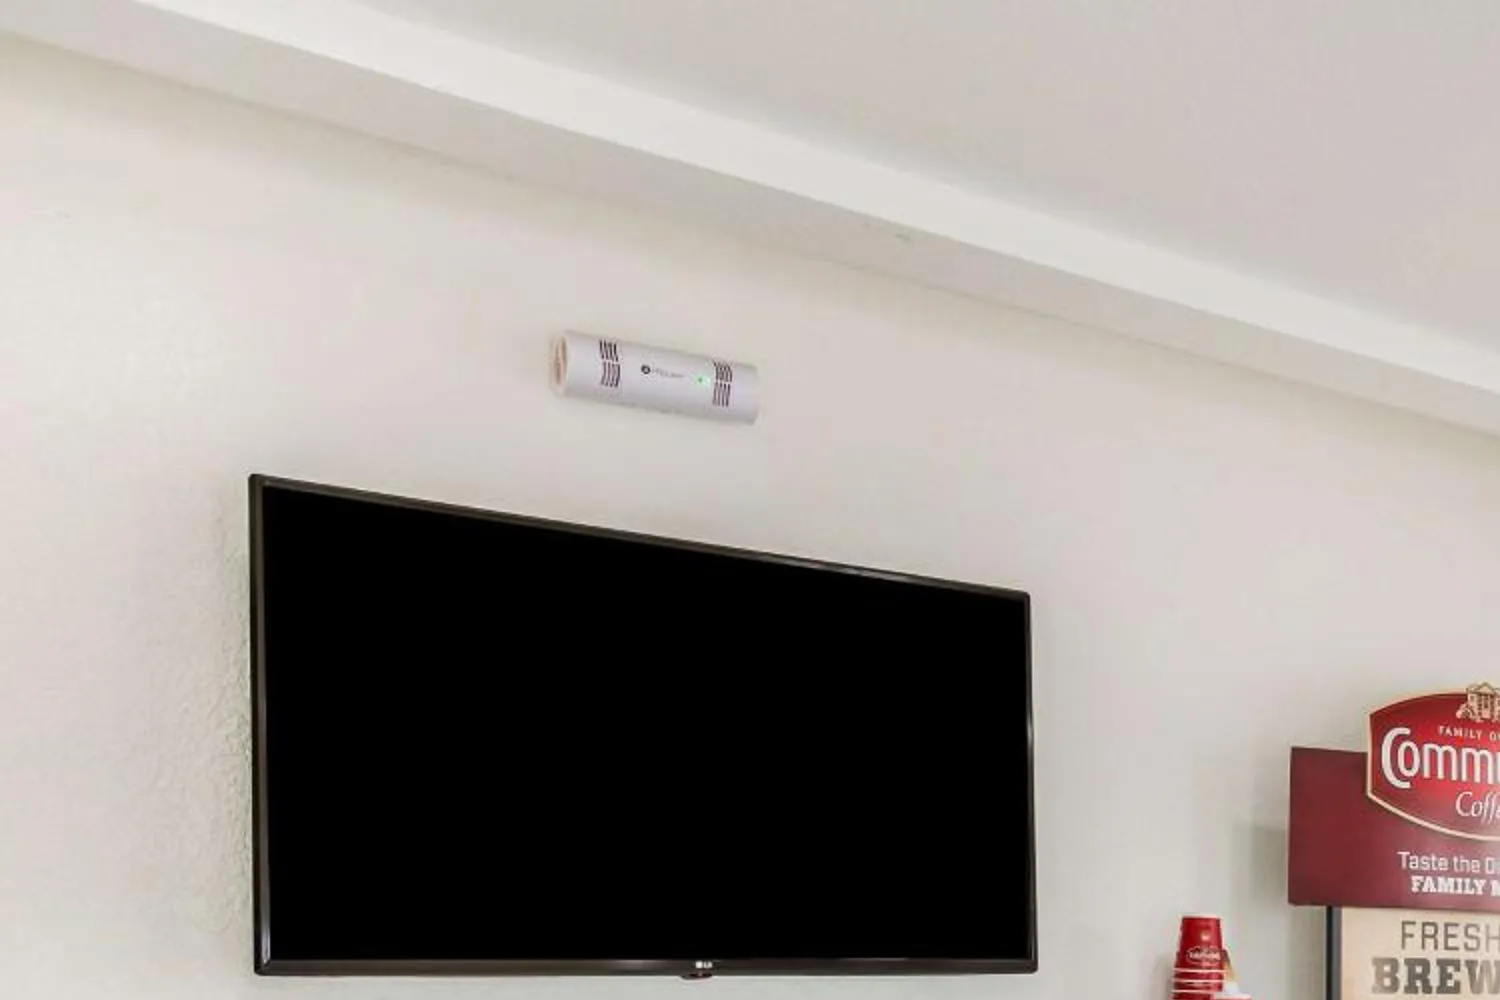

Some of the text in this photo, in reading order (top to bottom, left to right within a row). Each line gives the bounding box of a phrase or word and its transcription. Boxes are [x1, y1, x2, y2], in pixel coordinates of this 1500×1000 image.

[1438, 725, 1483, 742] FAMILY
[1398, 851, 1449, 873] Taste
[1453, 854, 1480, 874] the
[1410, 874, 1487, 896] FAMILY
